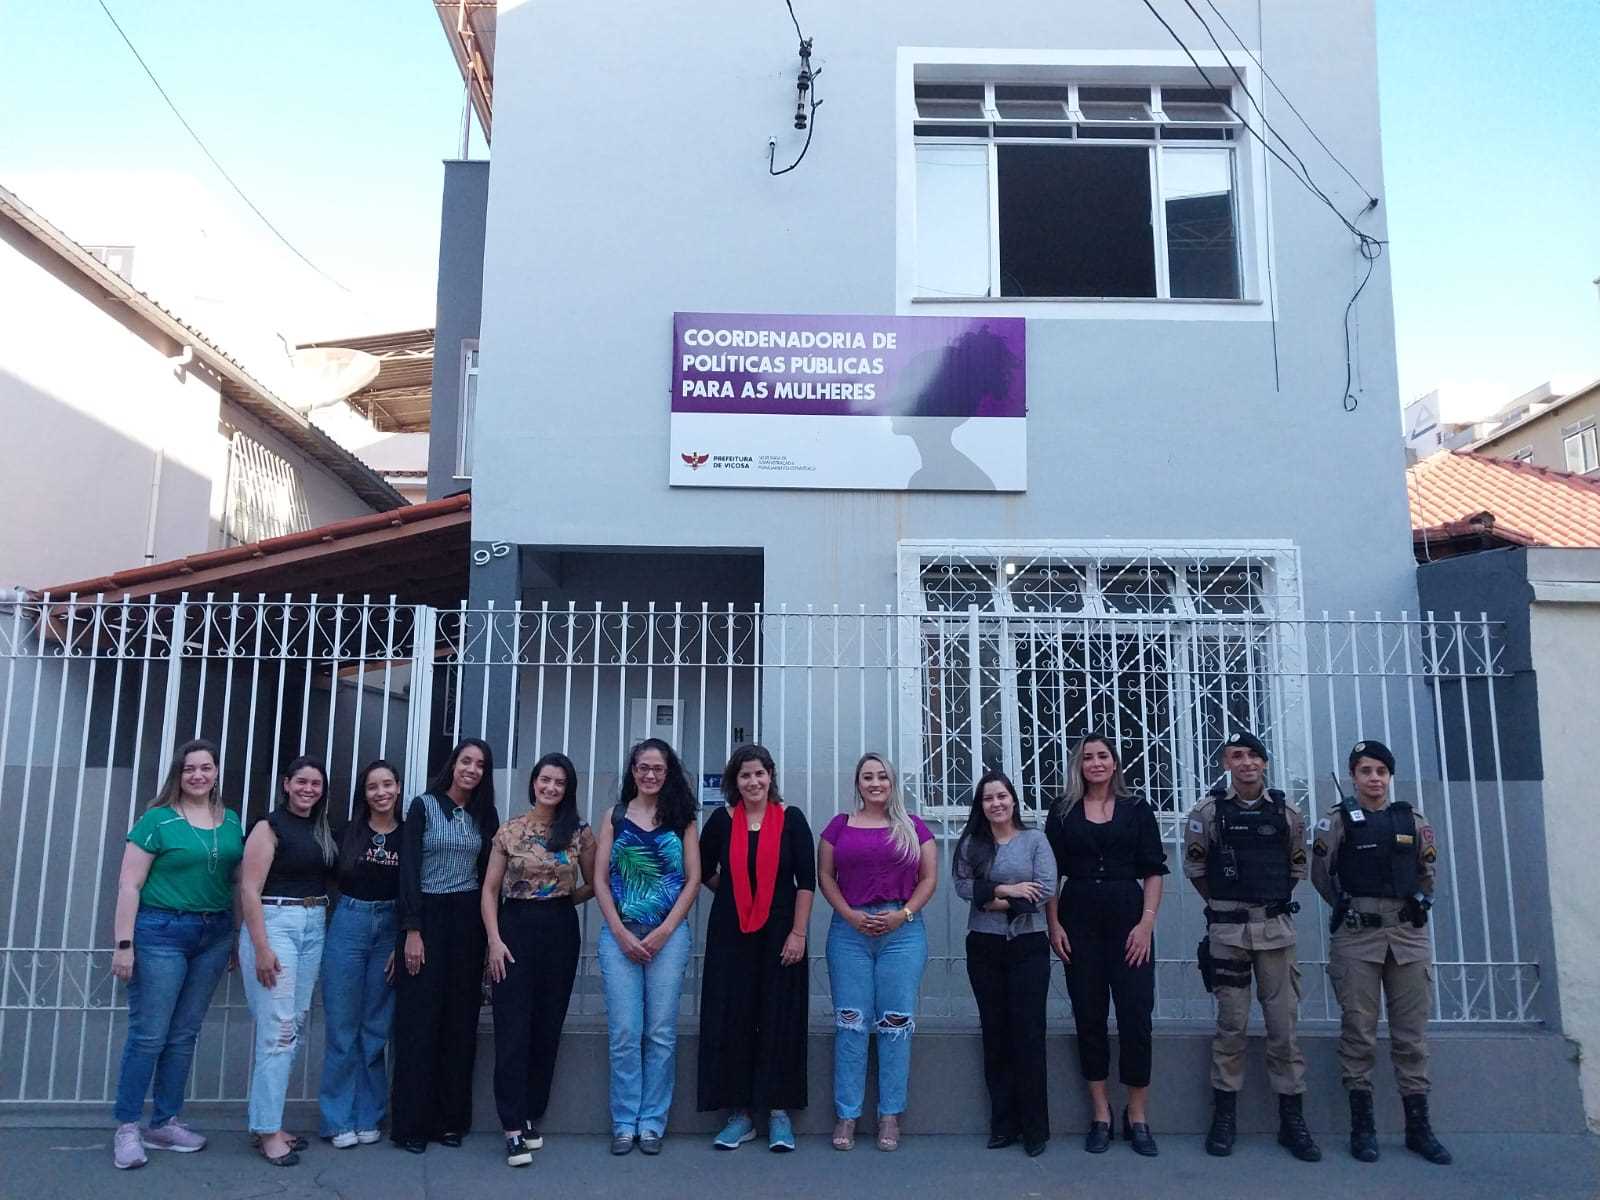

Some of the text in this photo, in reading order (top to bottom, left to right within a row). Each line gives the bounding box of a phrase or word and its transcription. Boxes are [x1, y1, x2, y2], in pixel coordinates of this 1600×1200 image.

[684, 329, 897, 349] COORDENADORIA DE
[682, 352, 884, 374] POLÍTICAS PÚBLICAS
[682, 380, 876, 400] PARA AS MULHERES
[473, 540, 510, 565] 95
